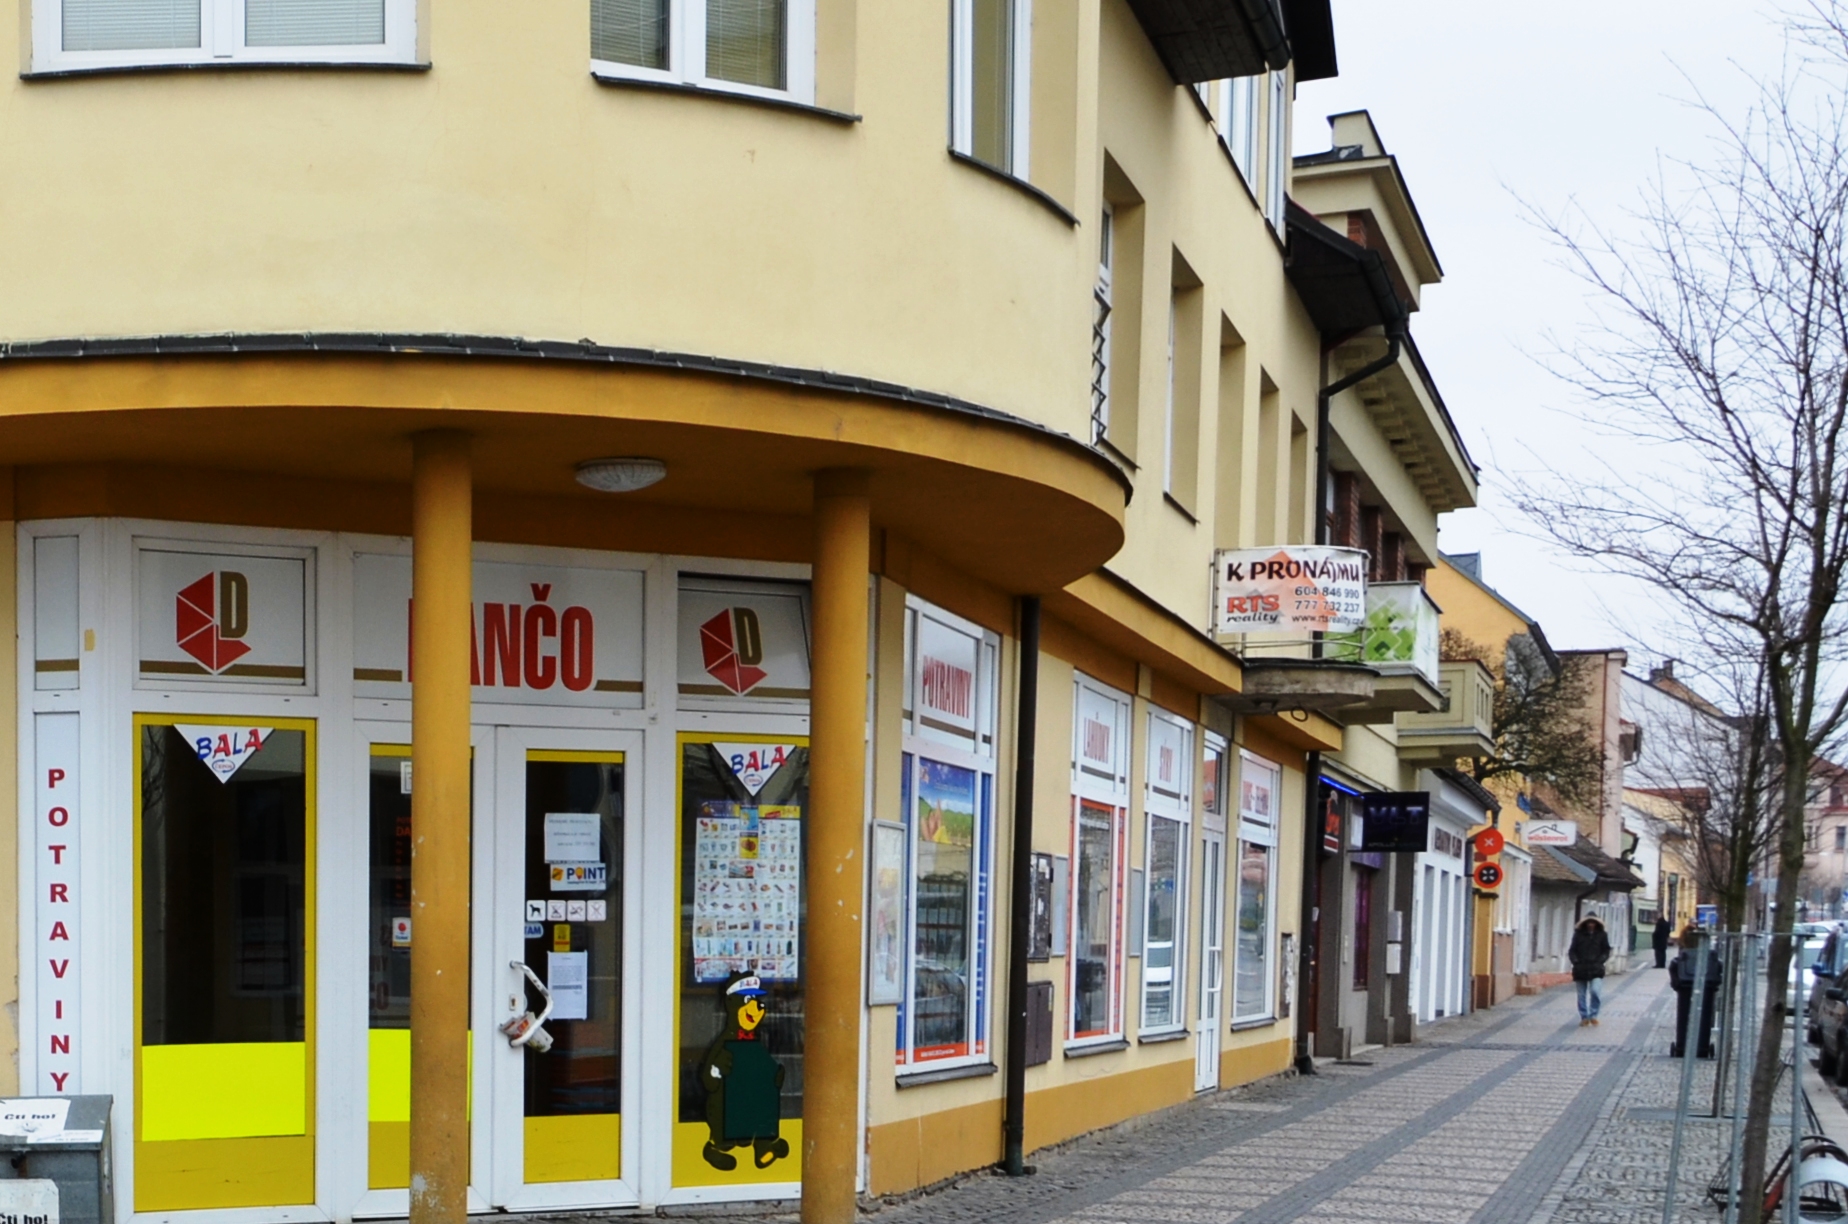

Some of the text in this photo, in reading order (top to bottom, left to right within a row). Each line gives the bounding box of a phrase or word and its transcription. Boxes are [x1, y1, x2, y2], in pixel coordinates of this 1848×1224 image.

[1227, 556, 1360, 583] K PRONÁJMU
[1227, 594, 1280, 614] RTS
[1294, 586, 1359, 599] 604 846 990
[1227, 611, 1279, 624] reality
[1295, 600, 1360, 613] 777 732 237
[922, 655, 972, 719] POTRAVINY
[196, 728, 263, 761] BALA
[730, 745, 787, 775] BALA
[48, 768, 70, 1092] POTRAVINY
